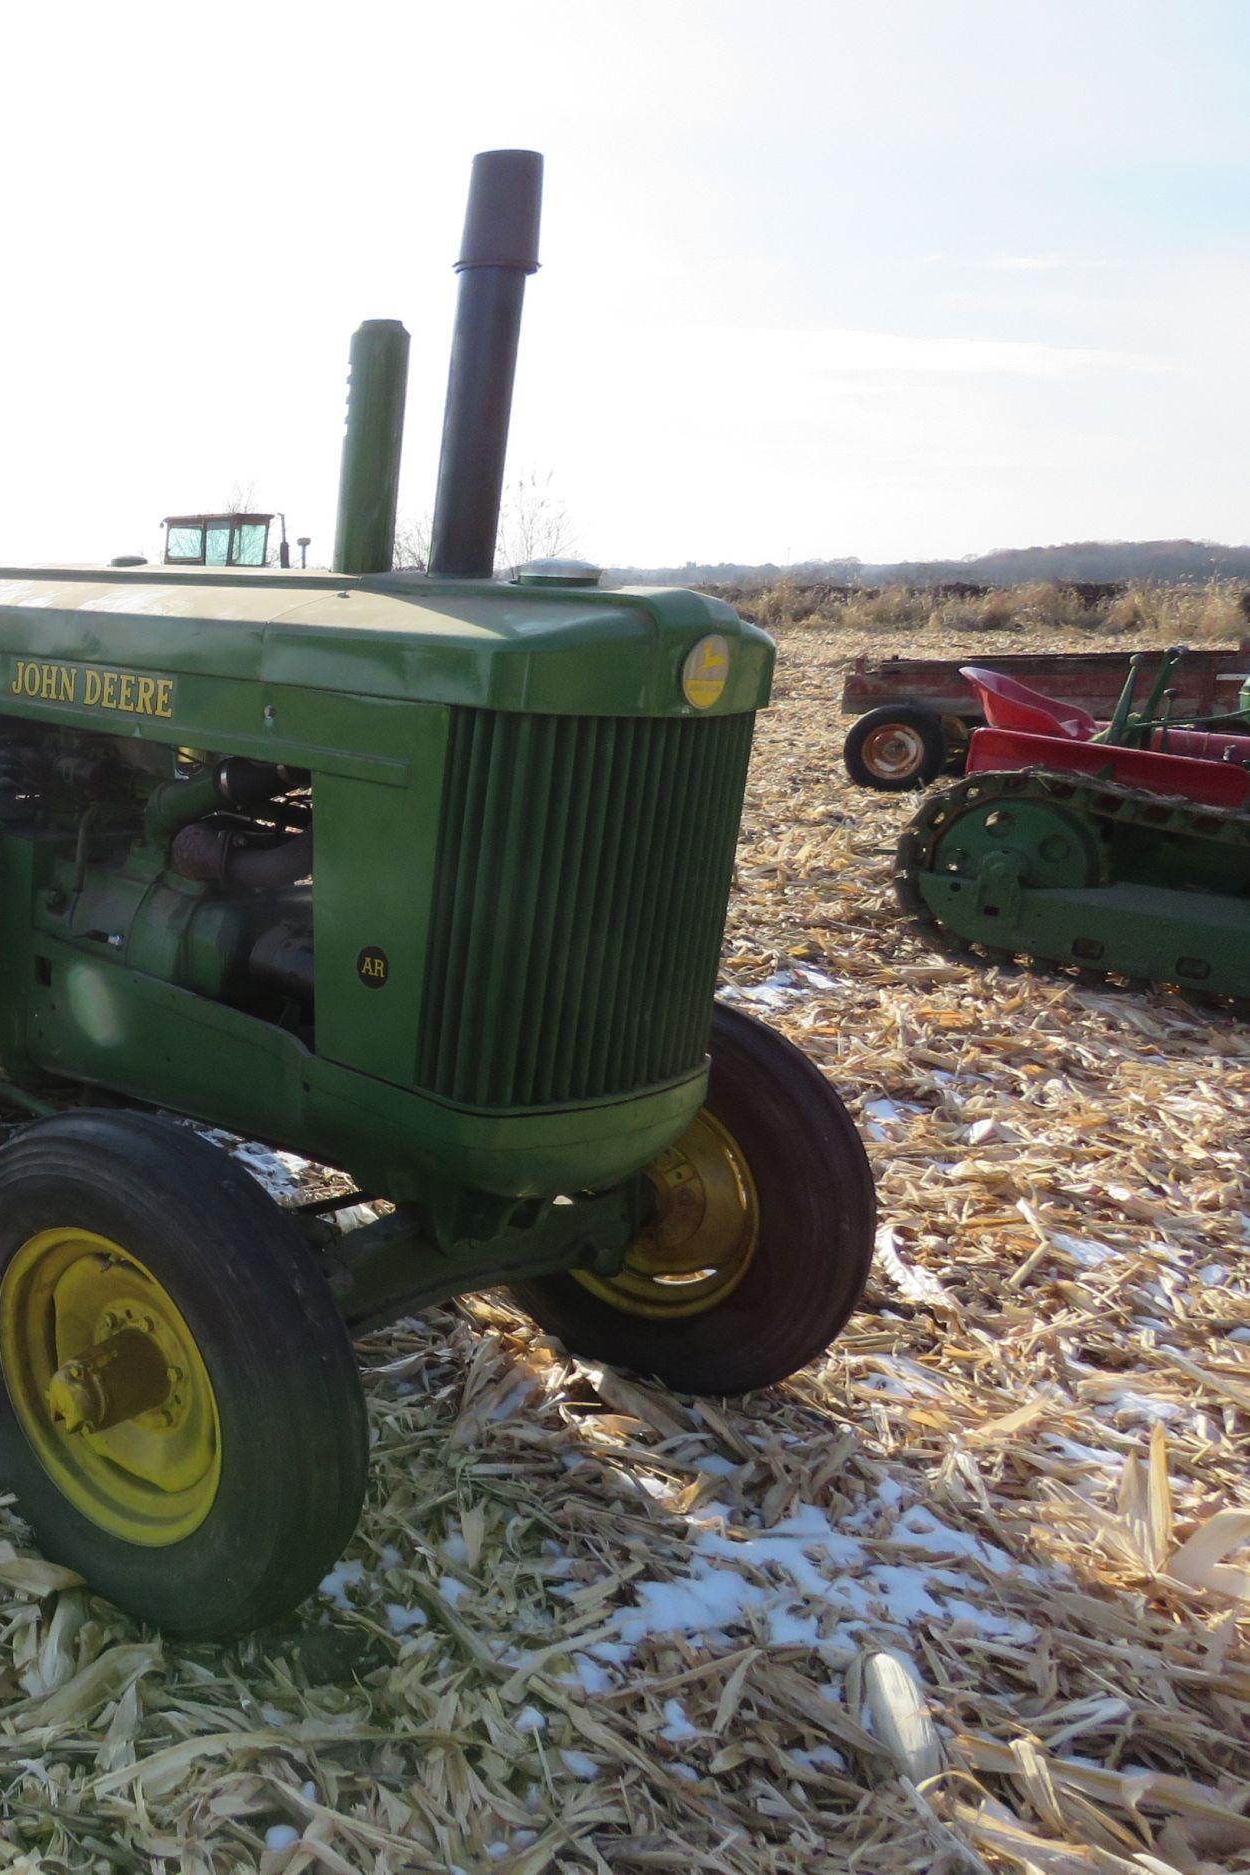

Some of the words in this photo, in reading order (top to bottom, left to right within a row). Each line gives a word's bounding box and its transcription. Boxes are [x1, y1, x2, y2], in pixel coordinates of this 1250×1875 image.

[12, 661, 78, 702] JOHN
[83, 670, 174, 718] DEERE
[361, 956, 385, 978] AR
